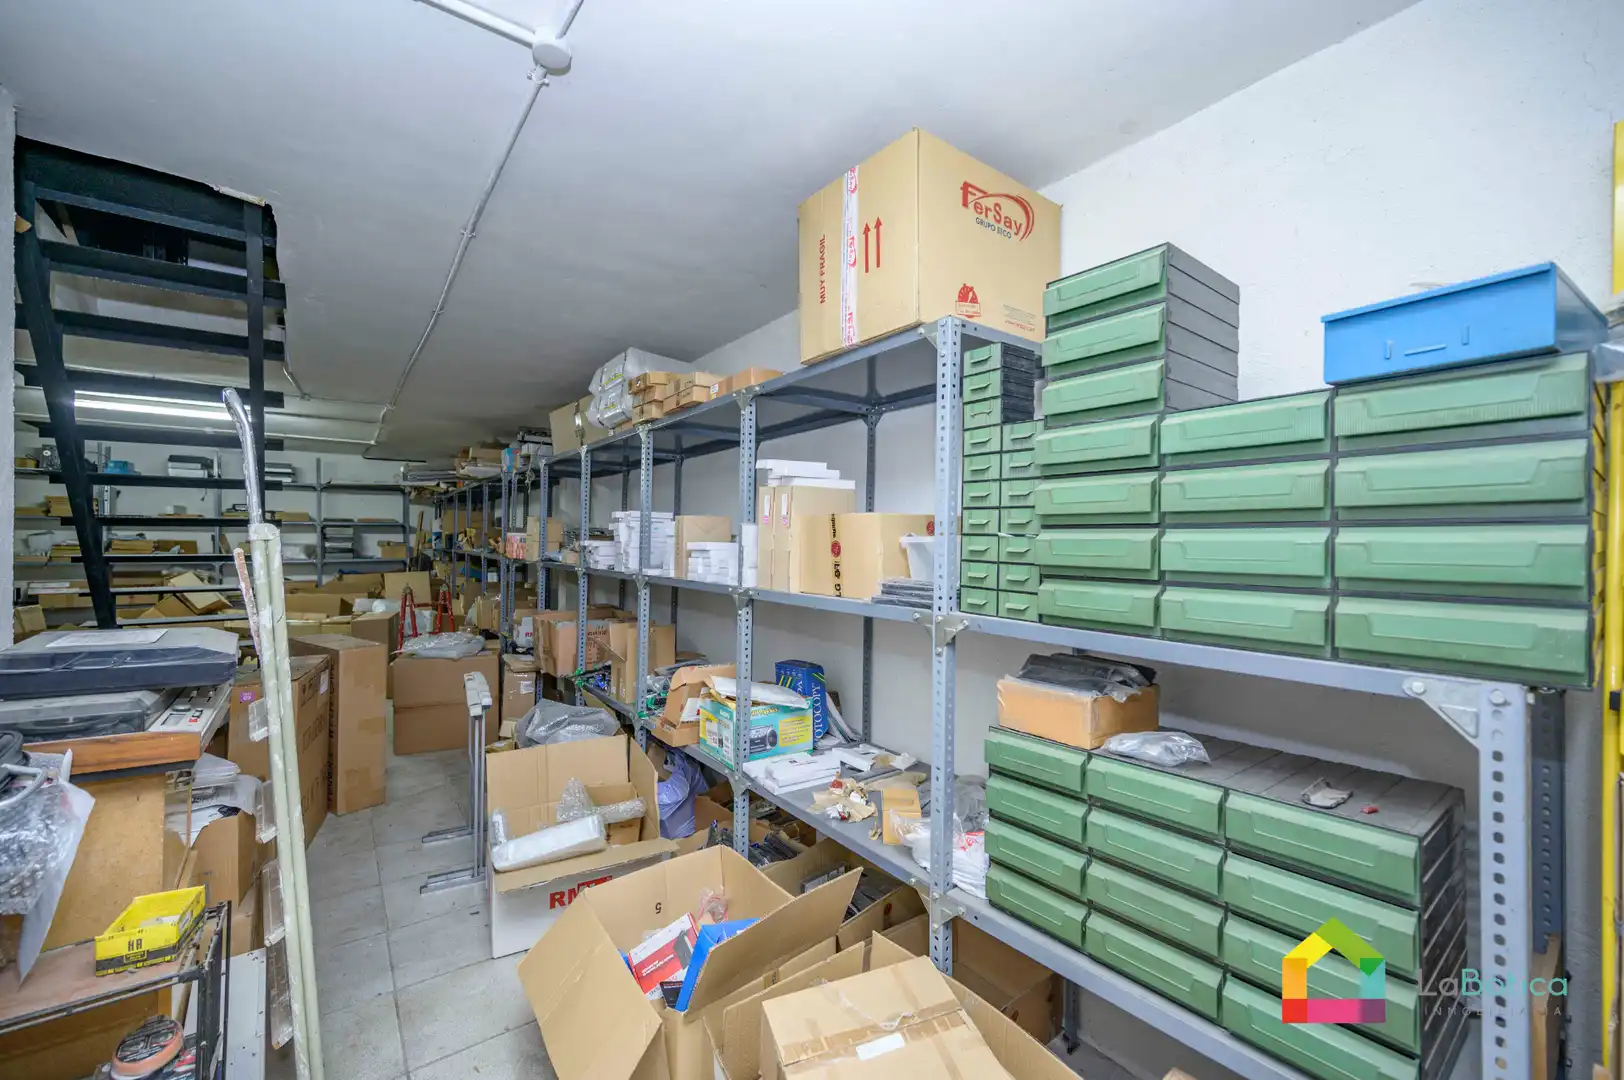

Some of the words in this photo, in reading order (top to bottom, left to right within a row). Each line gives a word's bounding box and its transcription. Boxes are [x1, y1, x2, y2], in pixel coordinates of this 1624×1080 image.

[960, 180, 1028, 239] FerSay
[975, 216, 996, 232] GRUPO
[818, 279, 826, 304] MUY
[833, 583, 842, 598] LG
[811, 685, 824, 743] OTOCOPY
